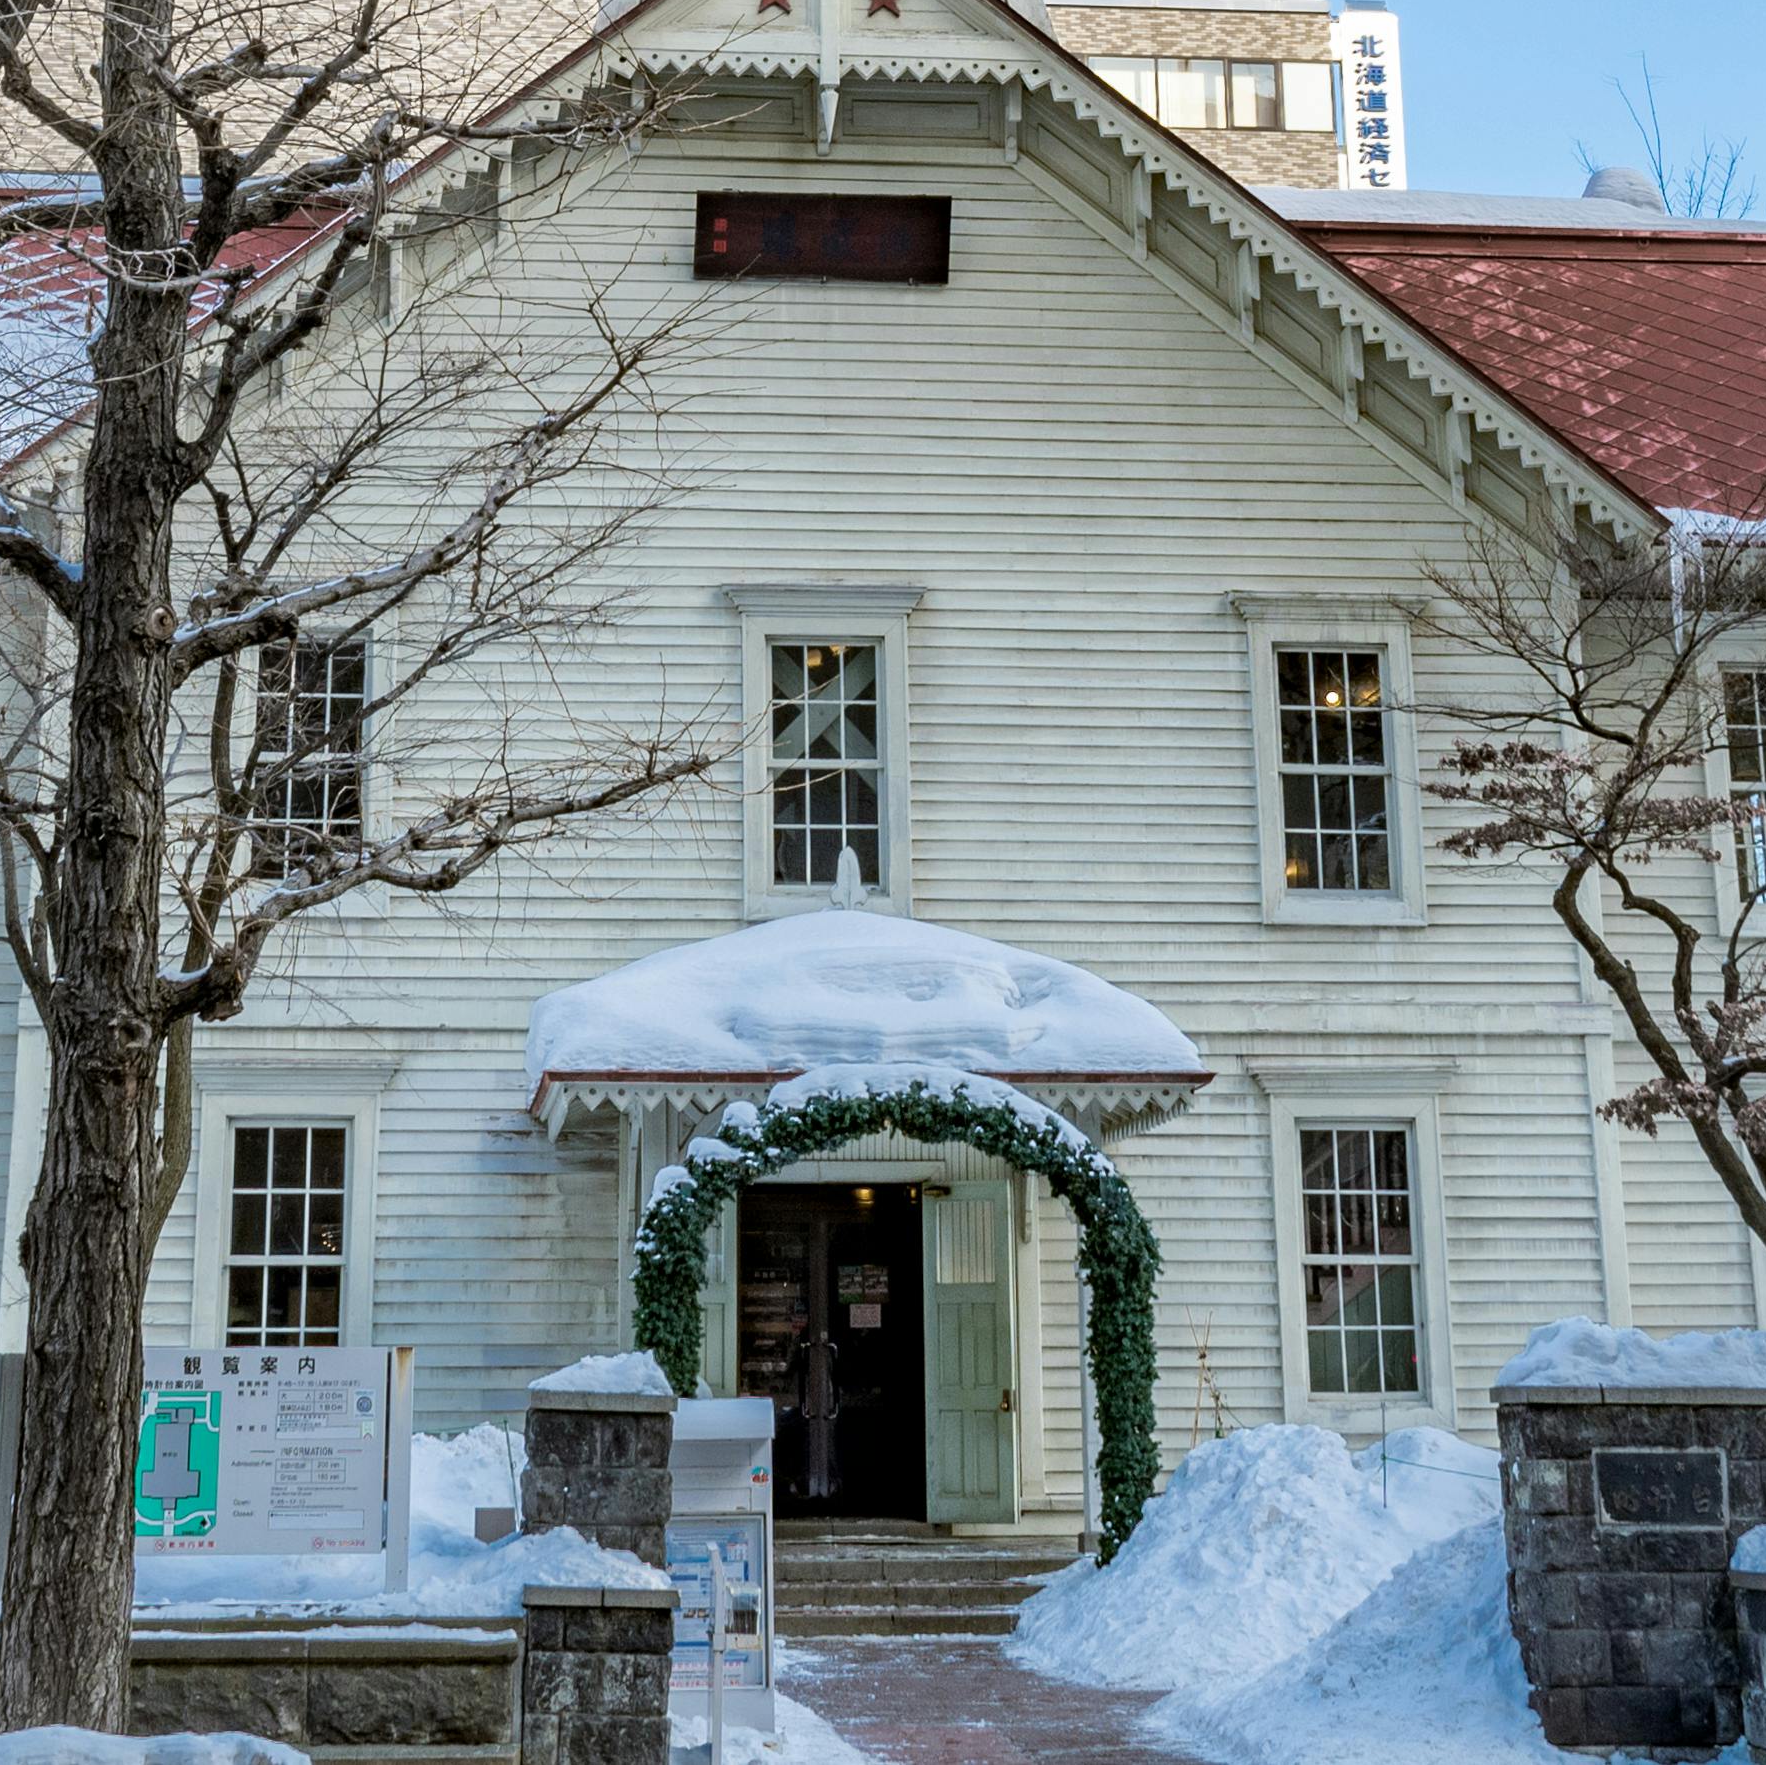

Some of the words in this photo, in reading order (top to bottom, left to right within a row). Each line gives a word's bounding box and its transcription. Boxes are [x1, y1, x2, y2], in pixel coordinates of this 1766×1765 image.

[1351, 34, 1391, 188] 北海道経済セ
[183, 1355, 316, 1376] 観覧案内
[279, 1446, 334, 1457] INFORMATION
